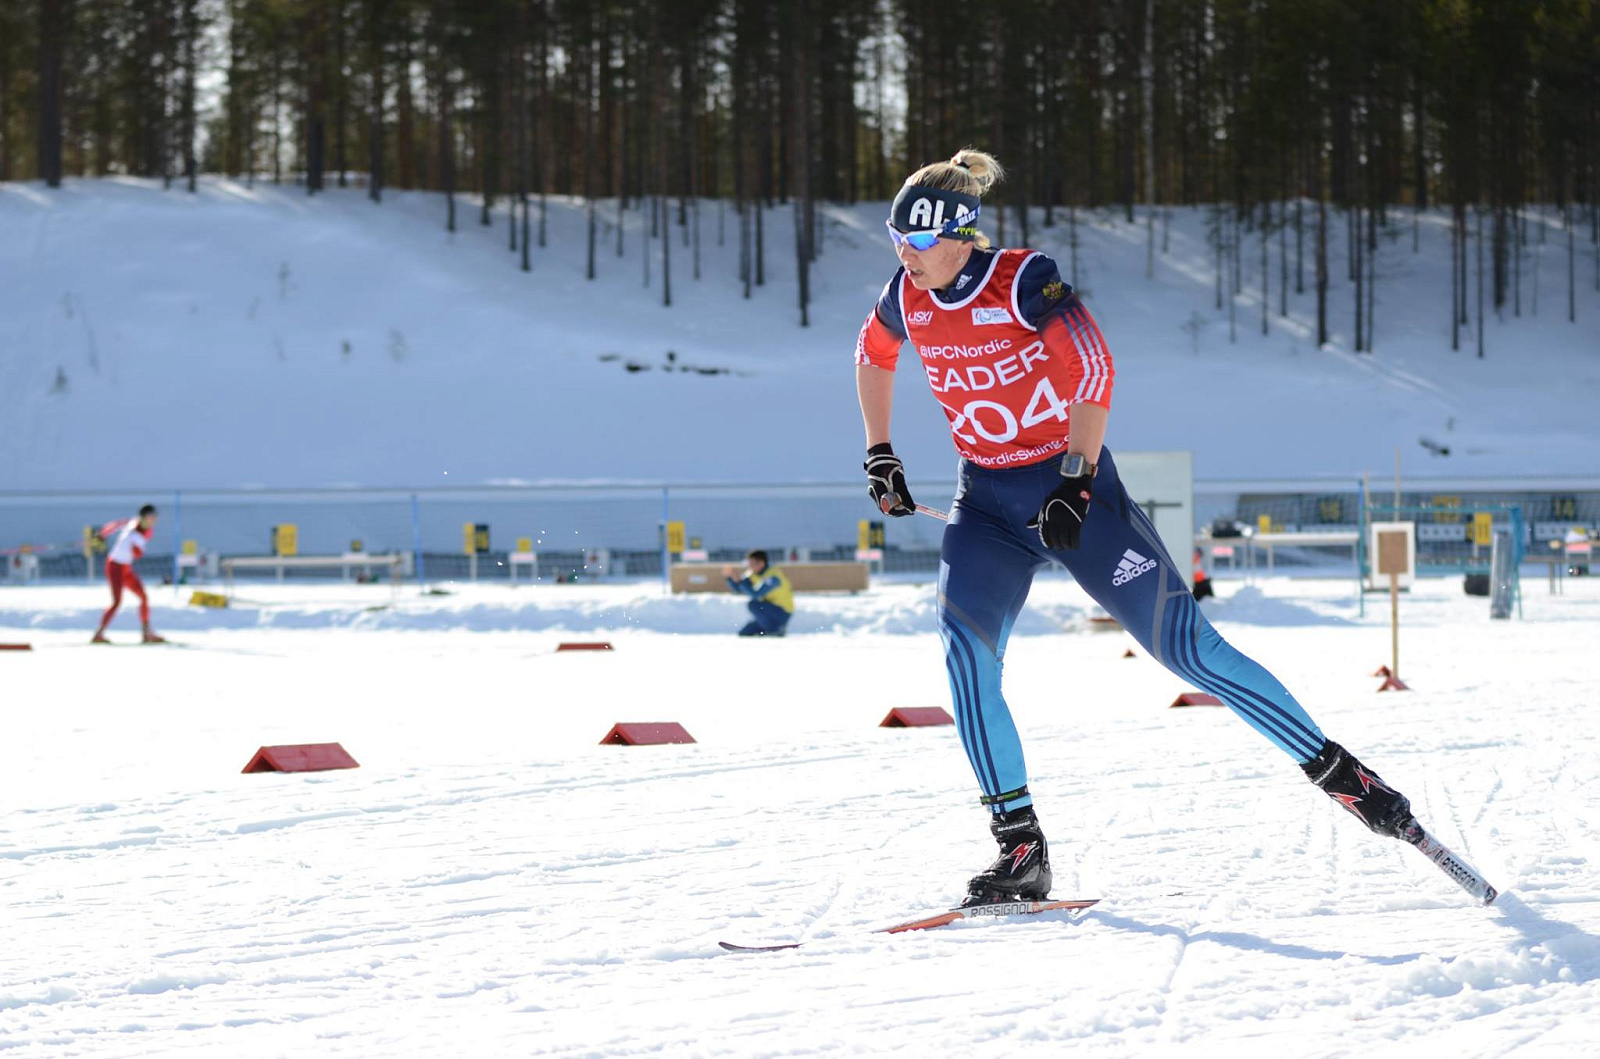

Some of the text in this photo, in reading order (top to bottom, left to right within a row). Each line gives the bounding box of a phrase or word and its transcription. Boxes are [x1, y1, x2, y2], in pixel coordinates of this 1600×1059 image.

[920, 339, 1012, 360] @IPCNordic
[925, 340, 1050, 393] EADER
[1112, 559, 1157, 586] adidas
[970, 903, 1034, 918] ROSSIGNOL
